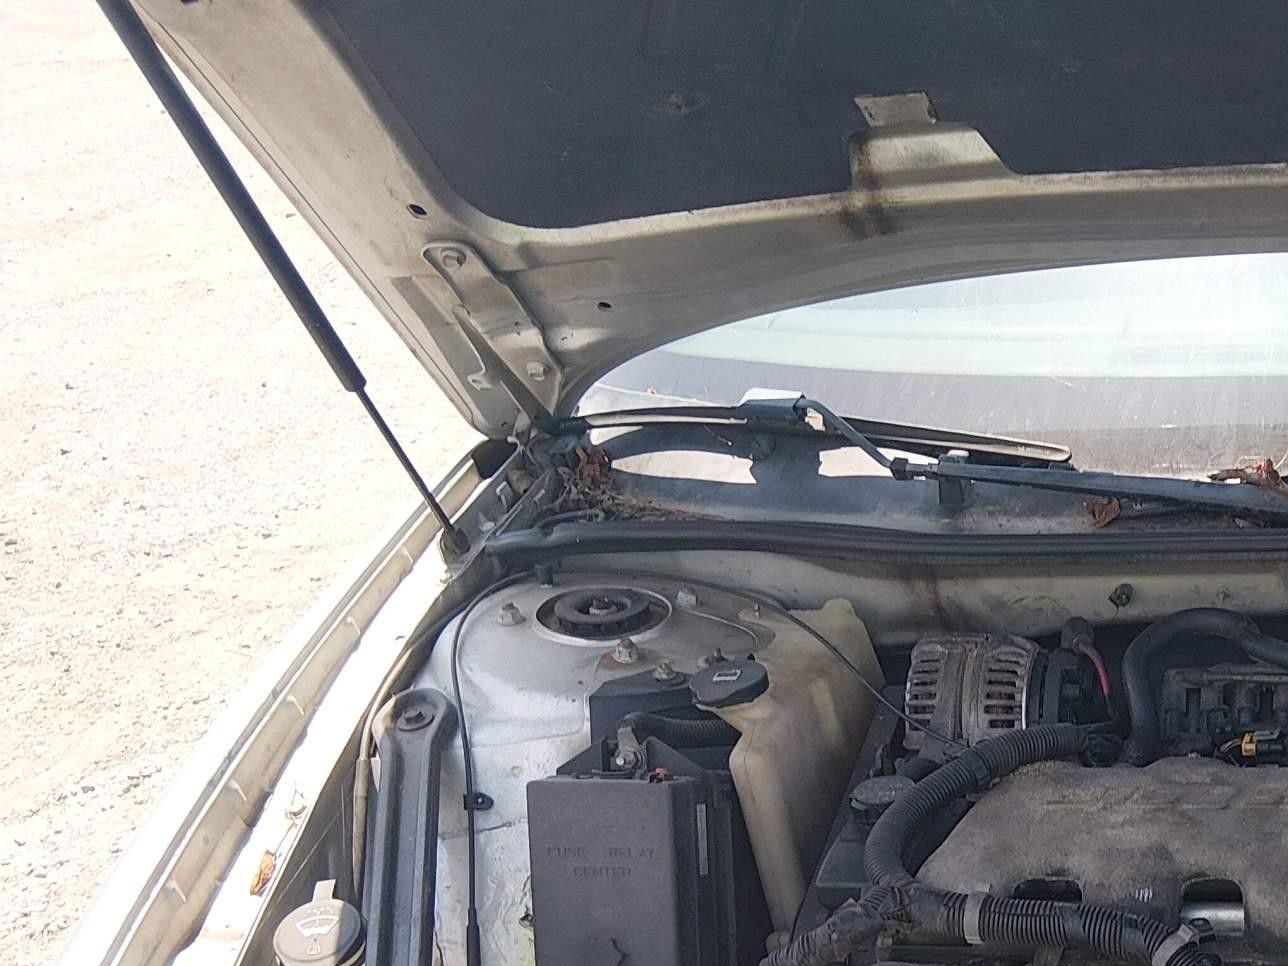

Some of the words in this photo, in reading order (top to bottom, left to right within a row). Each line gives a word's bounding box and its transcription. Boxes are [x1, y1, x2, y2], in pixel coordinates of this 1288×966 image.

[546, 846, 586, 858] FUSE
[608, 846, 655, 859] RELAY
[573, 866, 632, 878] CENTER
